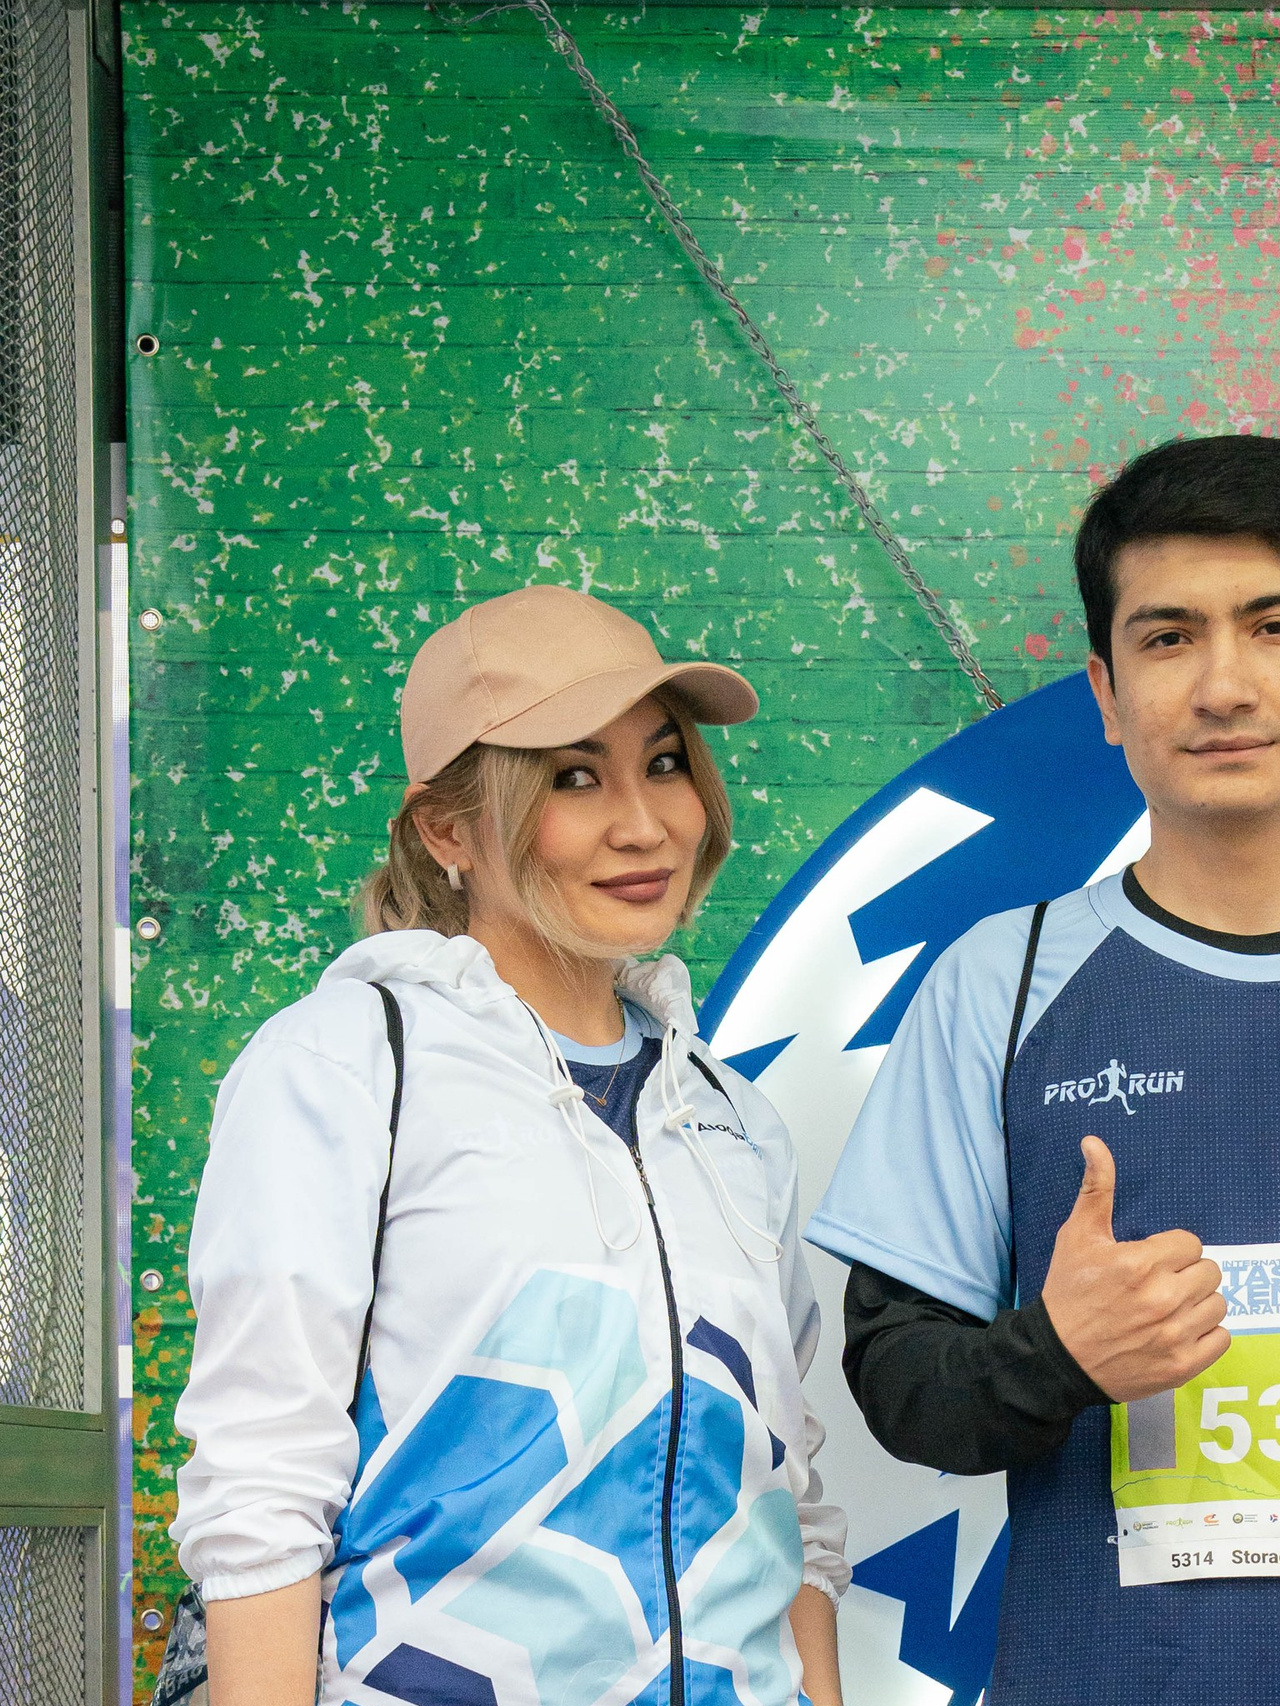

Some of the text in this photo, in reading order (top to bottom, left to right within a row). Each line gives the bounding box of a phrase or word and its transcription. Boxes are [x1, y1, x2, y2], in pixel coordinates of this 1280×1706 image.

[1044, 1070, 1184, 1105] PRO RUN
[1171, 1551, 1213, 1568] 5314
